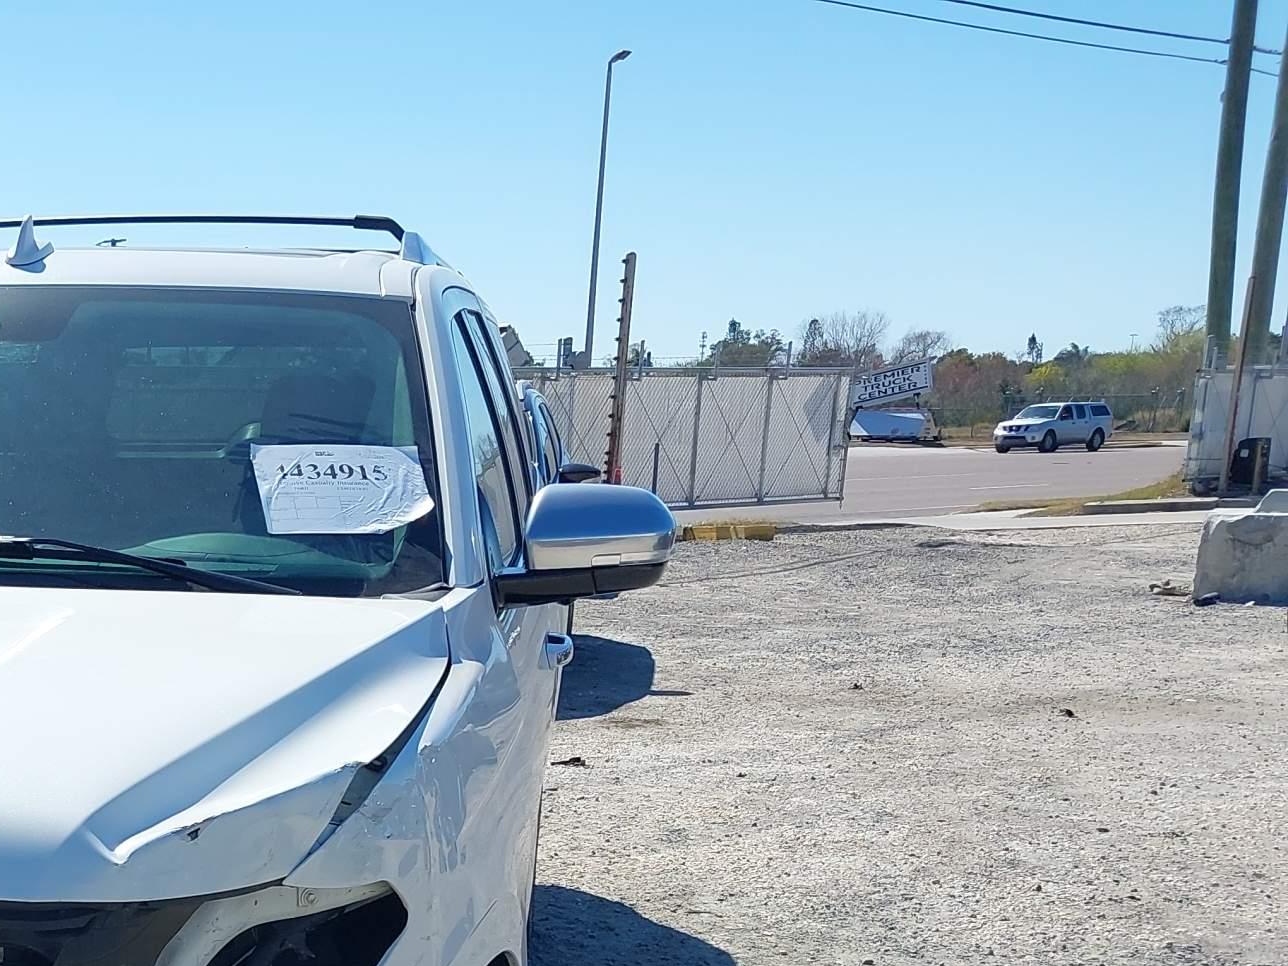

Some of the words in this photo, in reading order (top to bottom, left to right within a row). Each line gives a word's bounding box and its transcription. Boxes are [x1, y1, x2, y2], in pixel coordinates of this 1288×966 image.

[855, 366, 920, 386] PREMIER
[863, 375, 913, 392] TRUCK
[858, 382, 918, 401] CENTER
